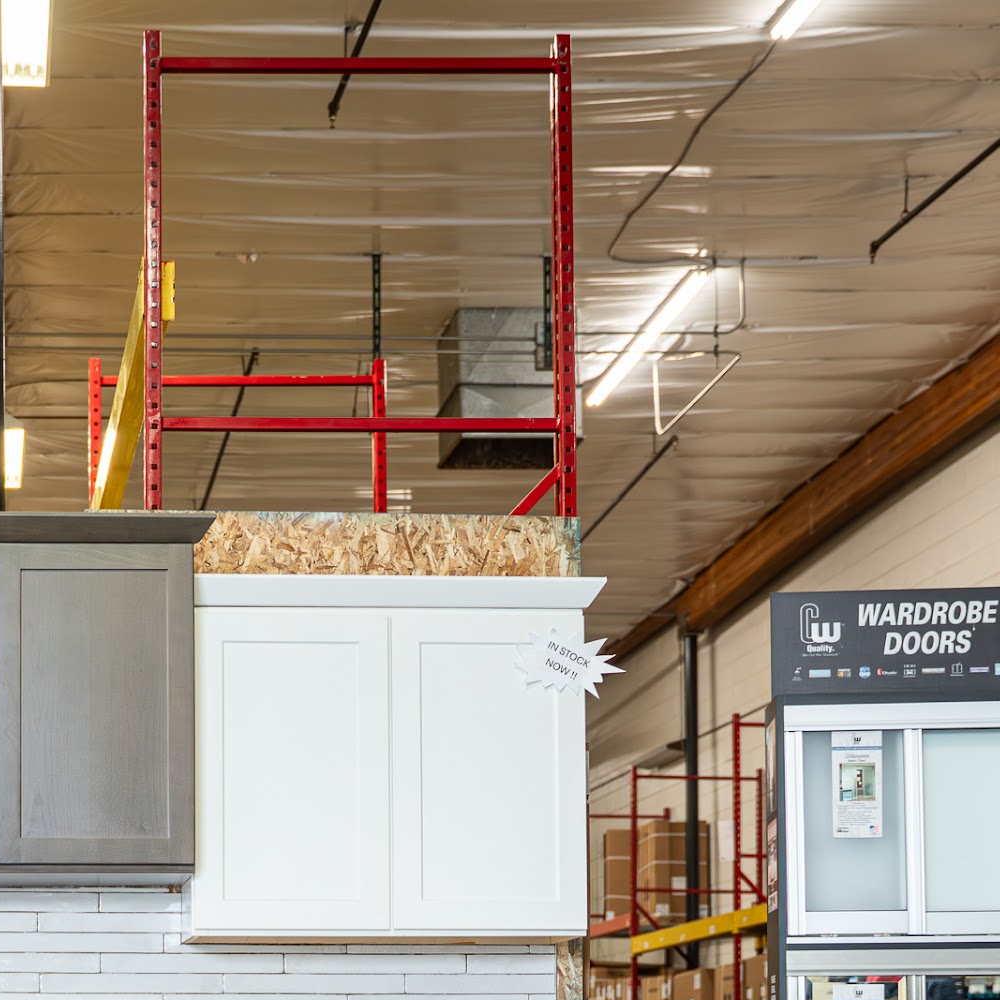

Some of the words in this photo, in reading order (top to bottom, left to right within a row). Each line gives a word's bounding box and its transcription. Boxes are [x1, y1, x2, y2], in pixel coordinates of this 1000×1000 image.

[858, 600, 999, 627] WARDROBE
[547, 640, 560, 652] IN
[559, 646, 591, 668] STOCK
[883, 630, 972, 655] DOORS
[545, 658, 571, 676] NOW
